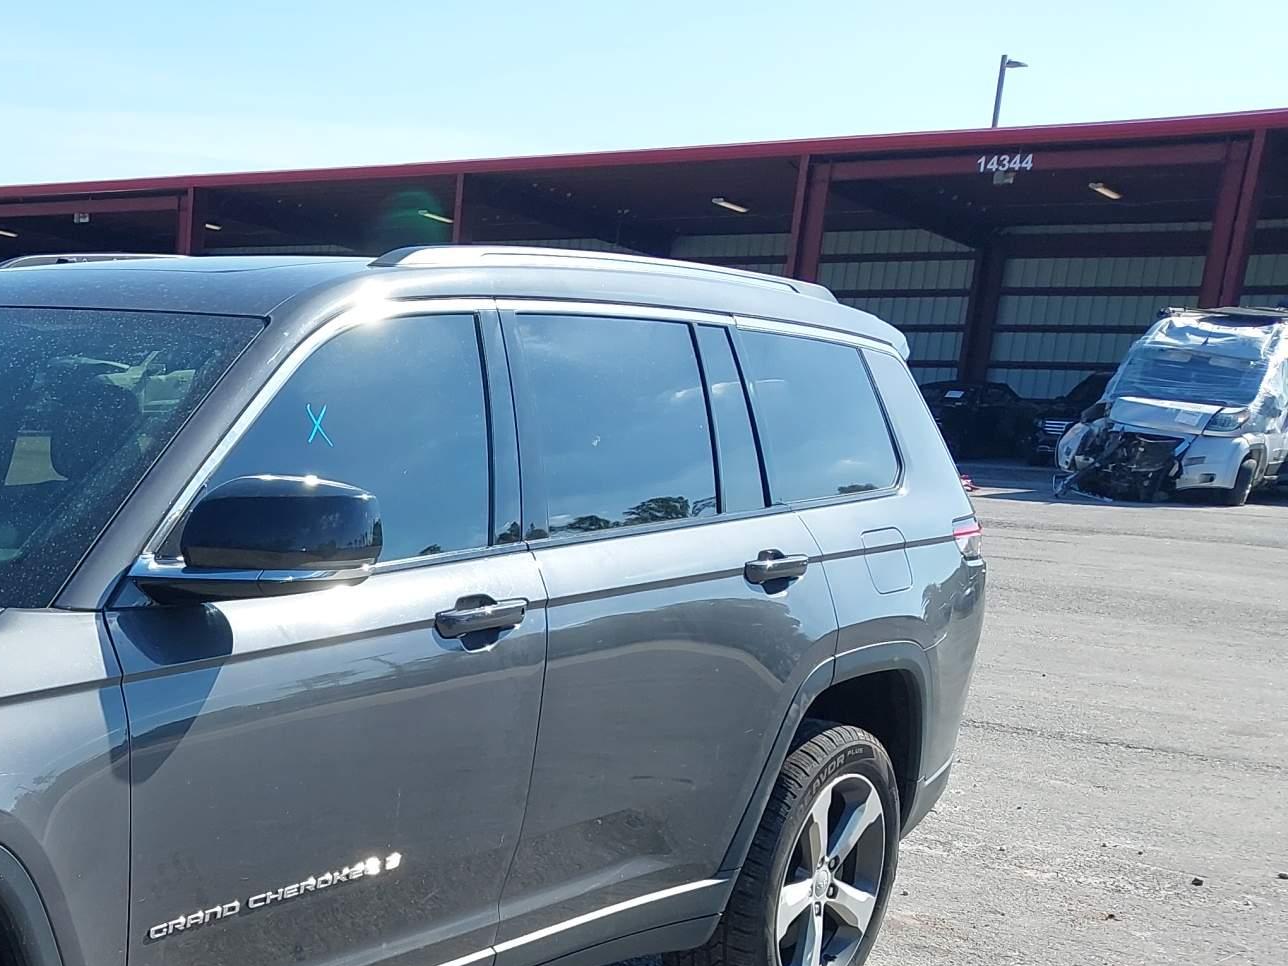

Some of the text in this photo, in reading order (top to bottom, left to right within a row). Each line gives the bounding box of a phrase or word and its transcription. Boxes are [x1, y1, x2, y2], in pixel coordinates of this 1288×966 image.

[977, 153, 1033, 172] 14344
[847, 747, 864, 756] PLUS
[148, 900, 241, 940] GRAND
